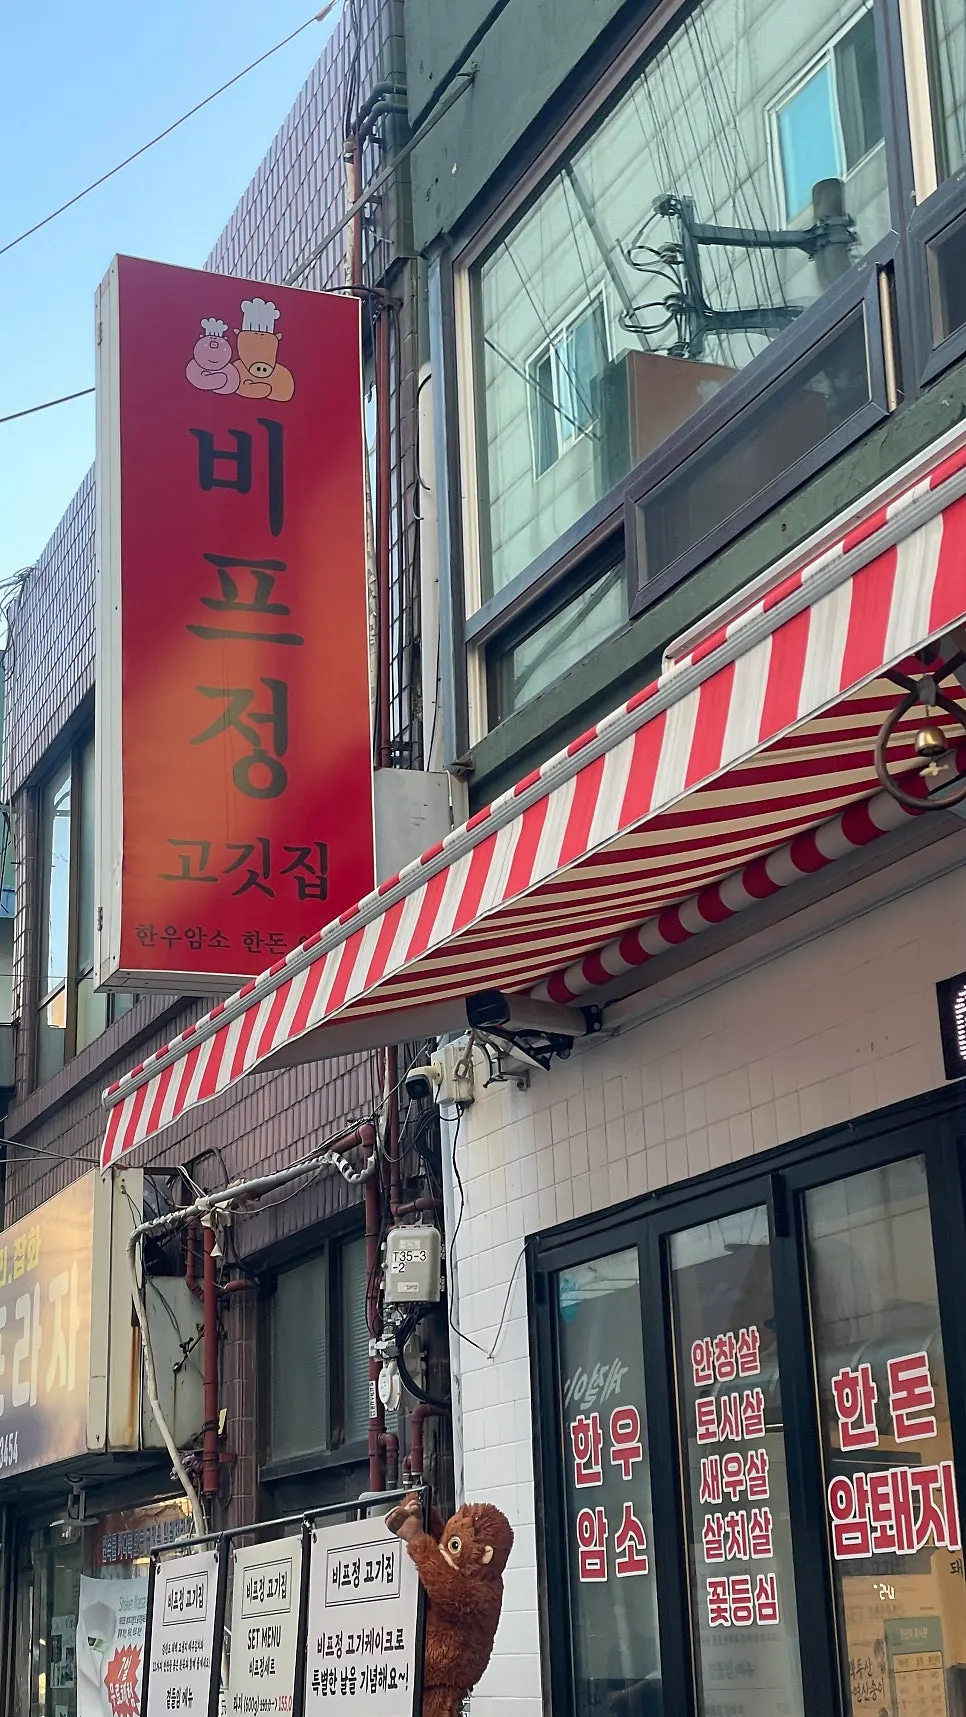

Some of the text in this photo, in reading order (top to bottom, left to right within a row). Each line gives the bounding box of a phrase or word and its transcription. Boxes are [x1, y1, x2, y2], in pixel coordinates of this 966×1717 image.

[186, 417, 304, 799] 비프정
[159, 837, 328, 901] 고깃집
[135, 923, 230, 950] 한우암소
[242, 930, 287, 955] 한돈
[393, 1250, 427, 1262] T35-3
[0, 1260, 81, 1417] 라자
[692, 1326, 760, 1387] 안창살
[695, 1387, 766, 1445] 토시살
[831, 1351, 937, 1452] 한돈
[570, 1405, 642, 1488] 한우
[700, 1449, 770, 1504] 새우살
[703, 1507, 772, 1563] 살치살
[827, 1461, 962, 1560] 암퇘지
[576, 1502, 649, 1583] 암소
[167, 1587, 185, 1612] 비프정
[186, 1583, 204, 1609] 고기집
[247, 1572, 288, 1604] 비프정 고기집
[333, 1552, 395, 1591] 비프정 고기집
[707, 1573, 779, 1627] 꽃등심
[247, 1625, 282, 1650] SET MENU
[317, 1626, 405, 1659] 비프정 고기케이크로
[249, 1656, 276, 1678] 비프정세트
[312, 1663, 409, 1696] 특별한 날을 기념해요~!
